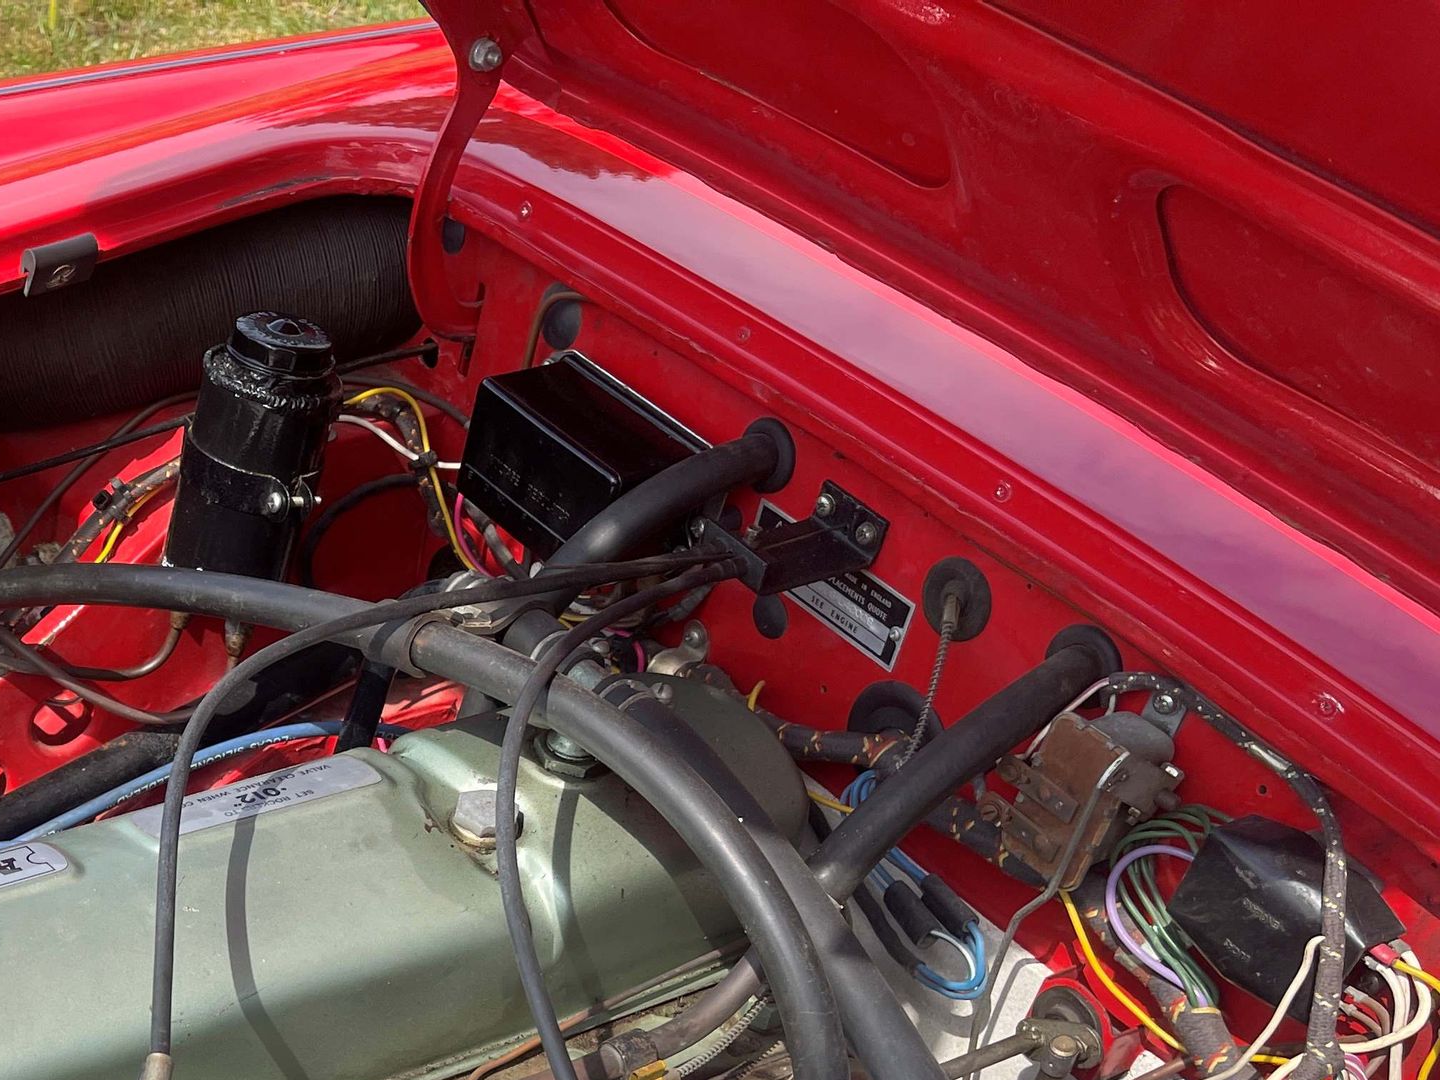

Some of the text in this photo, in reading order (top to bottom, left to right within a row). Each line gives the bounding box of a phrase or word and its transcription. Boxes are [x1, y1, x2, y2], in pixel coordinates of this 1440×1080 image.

[828, 577, 865, 605] PLACEMENTS
[867, 602, 888, 621] QUOTE
[870, 588, 892, 609] ENGLAND
[811, 595, 824, 610] SEE
[831, 609, 858, 634] ENGINE
[300, 763, 331, 777] VALVE
[233, 771, 297, 795] CLEARANCE
[197, 789, 231, 804] WHEN
